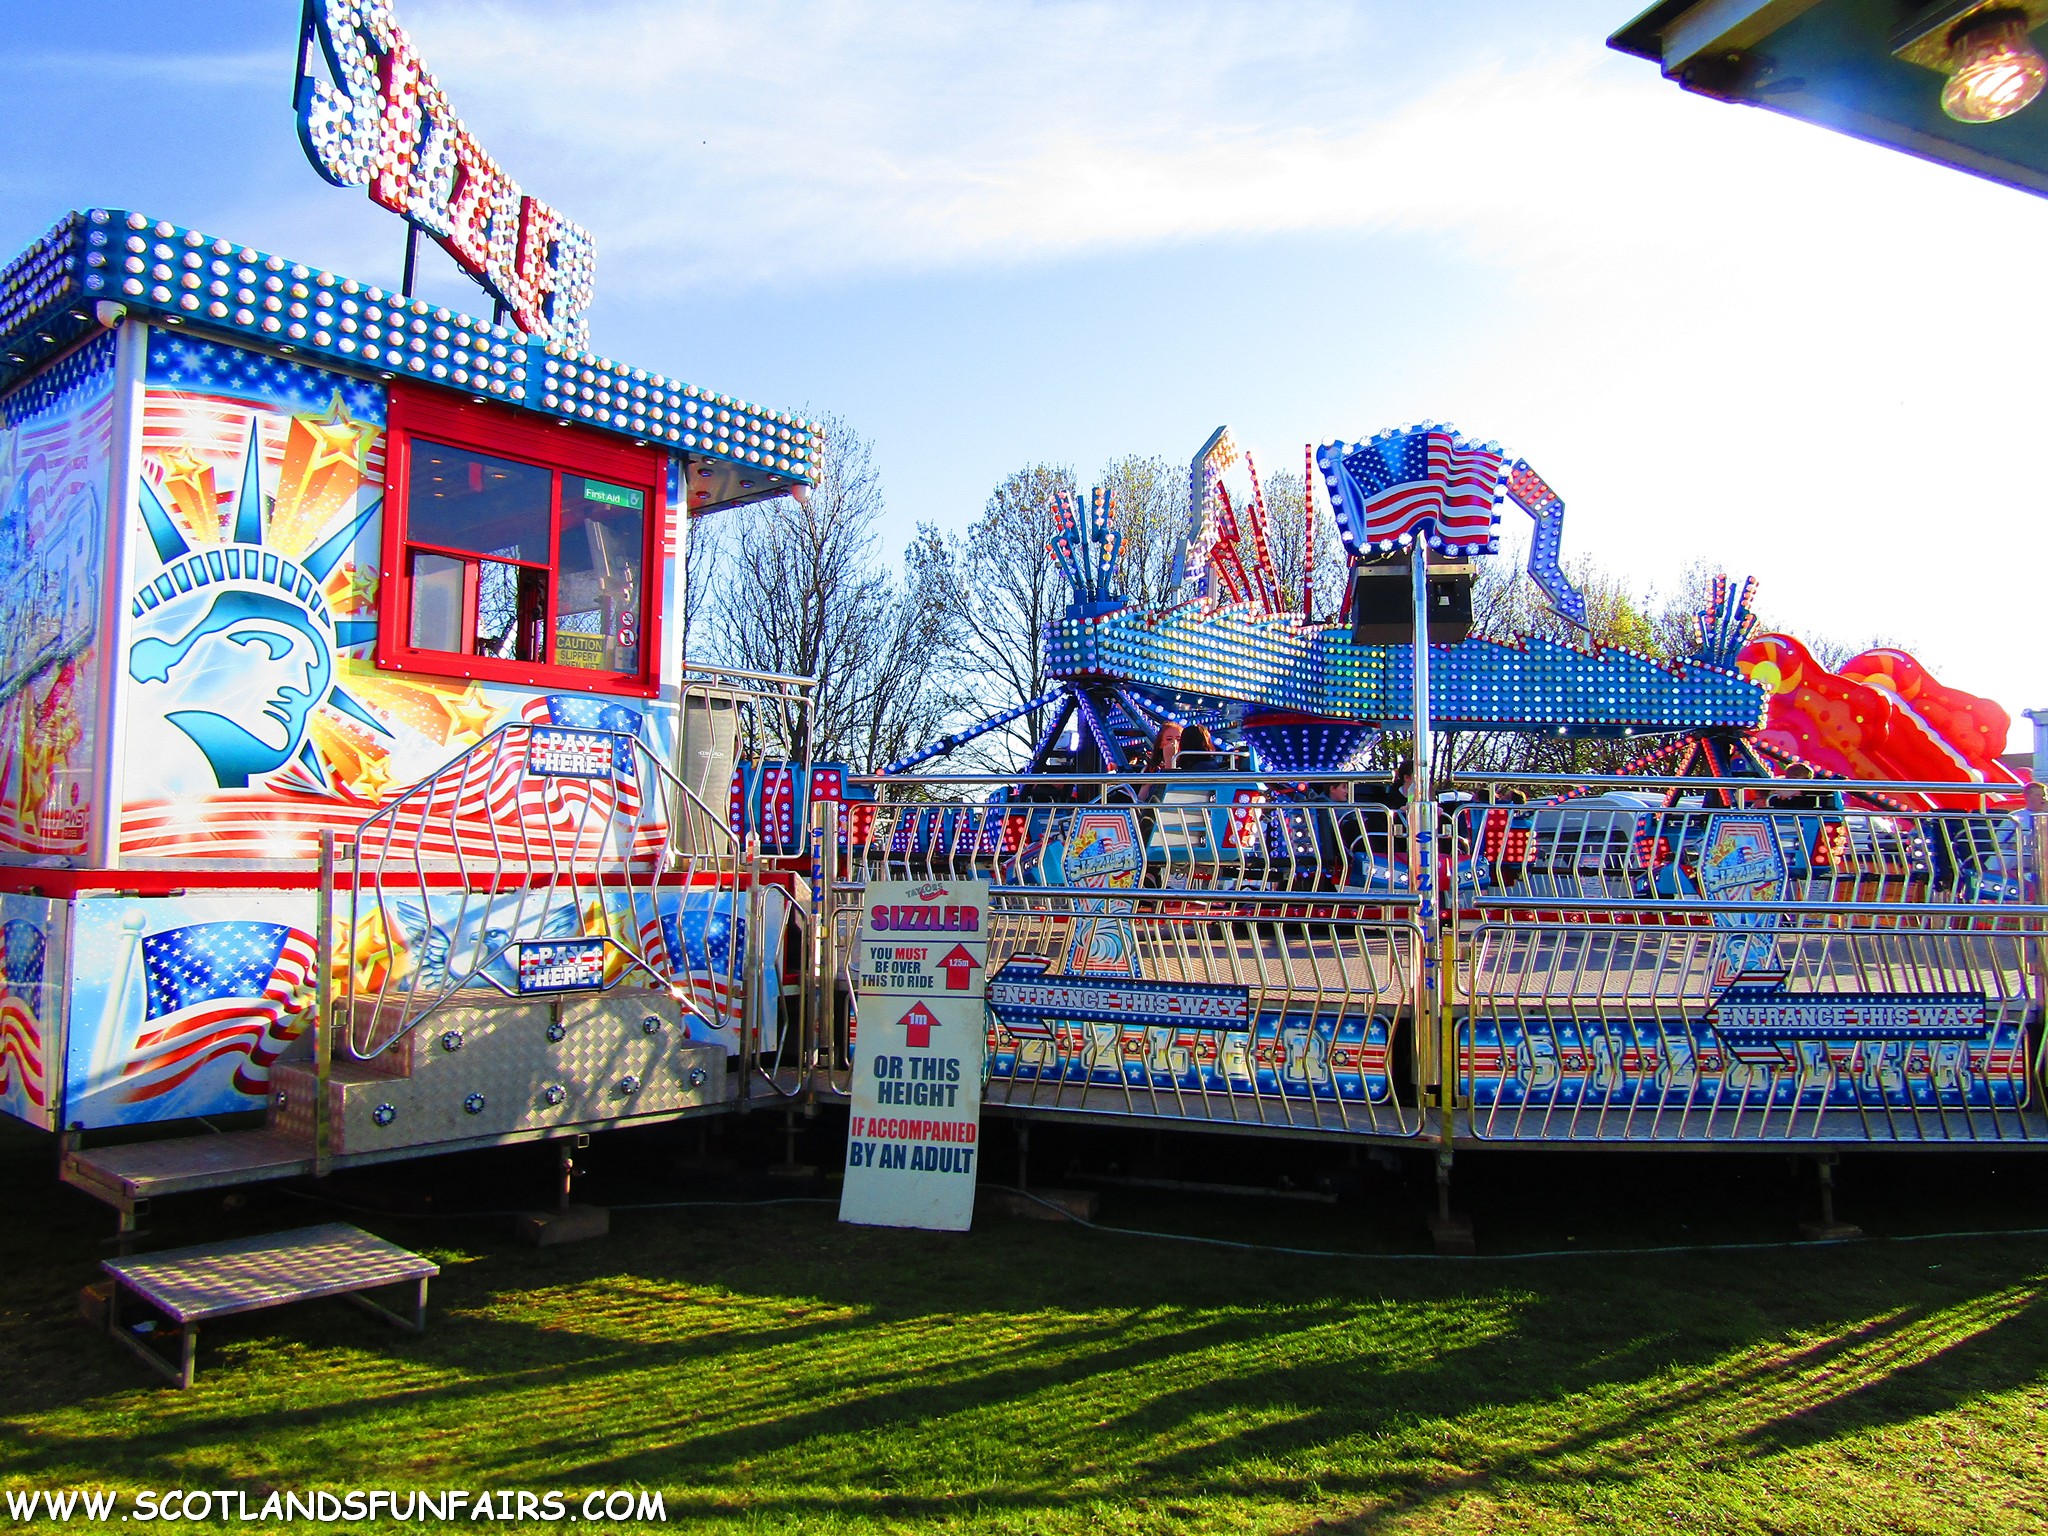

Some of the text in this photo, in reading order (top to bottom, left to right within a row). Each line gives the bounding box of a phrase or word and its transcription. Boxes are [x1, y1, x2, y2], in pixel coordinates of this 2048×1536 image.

[585, 488, 621, 503] First Aid
[1079, 604, 1084, 615] 1
[556, 636, 602, 651] CAUTION
[560, 649, 598, 662] SLIPPERY
[548, 731, 597, 755] PAY
[544, 752, 599, 775] HERE
[1069, 846, 1136, 881] SIZZLER
[1707, 857, 1778, 893] SIZZLER
[870, 904, 980, 932] SIZZLER
[538, 945, 588, 967] PAY
[870, 947, 929, 961] YOU MUST
[535, 964, 591, 987] HERE
[874, 961, 921, 974] BE OVER
[861, 974, 934, 988] THIS TO RIDE
[992, 985, 1244, 1018] ENTRANCE THIS WAY
[908, 1012, 928, 1026] 1m
[1716, 1006, 1981, 1028] ENTRANCE THIS WAY
[1018, 1018, 1330, 1083] ZZLER
[873, 1055, 960, 1082] OR THIS
[877, 1081, 959, 1108] HEIGHT
[851, 1117, 977, 1144] IF ACCOMPANIED
[849, 1141, 975, 1174] BY AN ADULT
